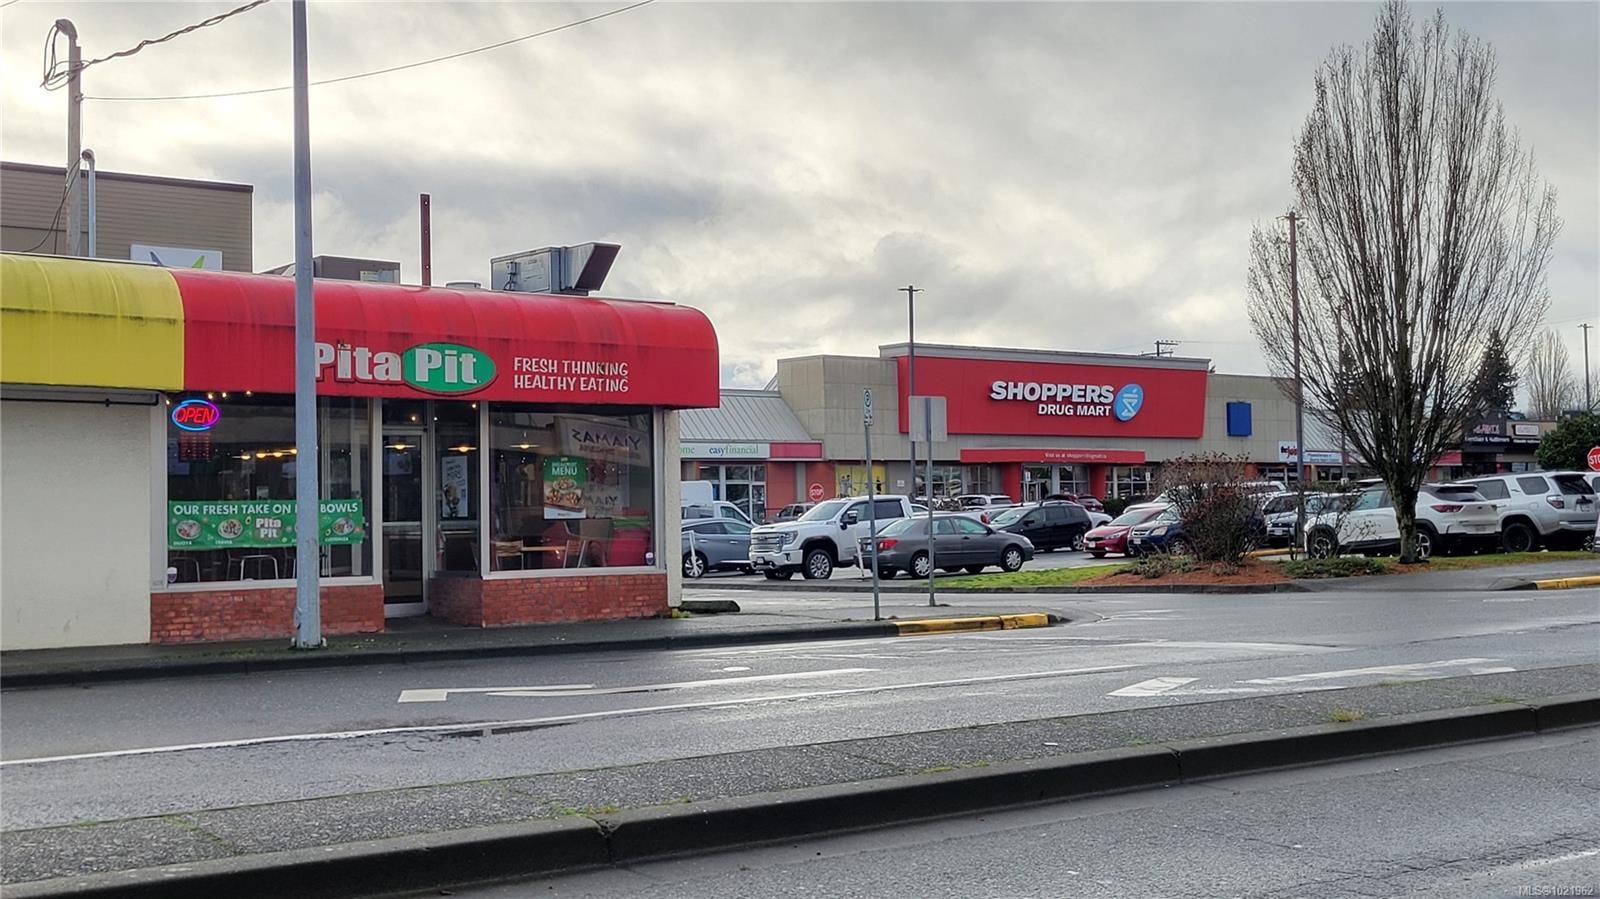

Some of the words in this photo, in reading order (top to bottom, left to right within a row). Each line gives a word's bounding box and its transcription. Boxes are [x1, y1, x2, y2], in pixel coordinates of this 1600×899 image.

[315, 342, 401, 381] Pita
[415, 348, 477, 384] Pit
[514, 357, 558, 373] FRESH
[562, 360, 629, 377] THINKING
[514, 374, 576, 391] HEALTHY
[580, 376, 629, 392] EATING
[990, 380, 1114, 403] SHOPPERS
[176, 407, 215, 423] OPEN
[1038, 403, 1074, 416] DRUG
[1076, 405, 1112, 416] MART
[709, 443, 759, 457] easyfinancial
[551, 466, 578, 476] MENU
[810, 488, 824, 496] STOP
[173, 504, 200, 515] OUR
[202, 503, 238, 515] FRESH
[241, 504, 269, 514] TAKE
[272, 504, 291, 514] ON
[320, 502, 358, 513] BOWLS
[255, 517, 282, 528] Pita
[259, 528, 278, 538] Pit
